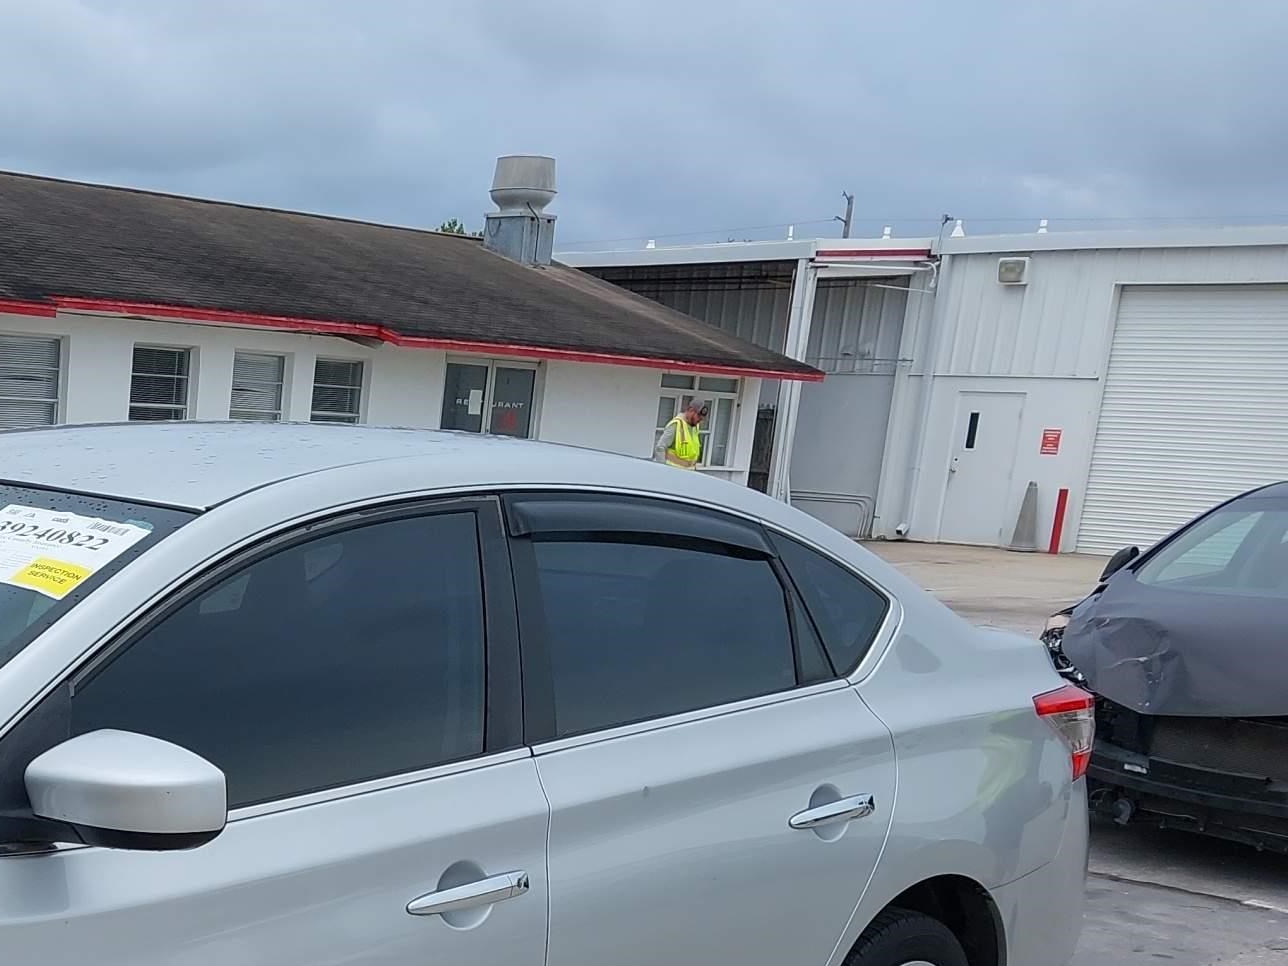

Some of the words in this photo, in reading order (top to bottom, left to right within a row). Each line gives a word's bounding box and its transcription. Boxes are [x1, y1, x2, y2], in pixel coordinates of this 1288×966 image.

[455, 398, 524, 408] REURANT
[27, 570, 67, 584] SERVICE
[30, 563, 82, 580] INSPECTION
